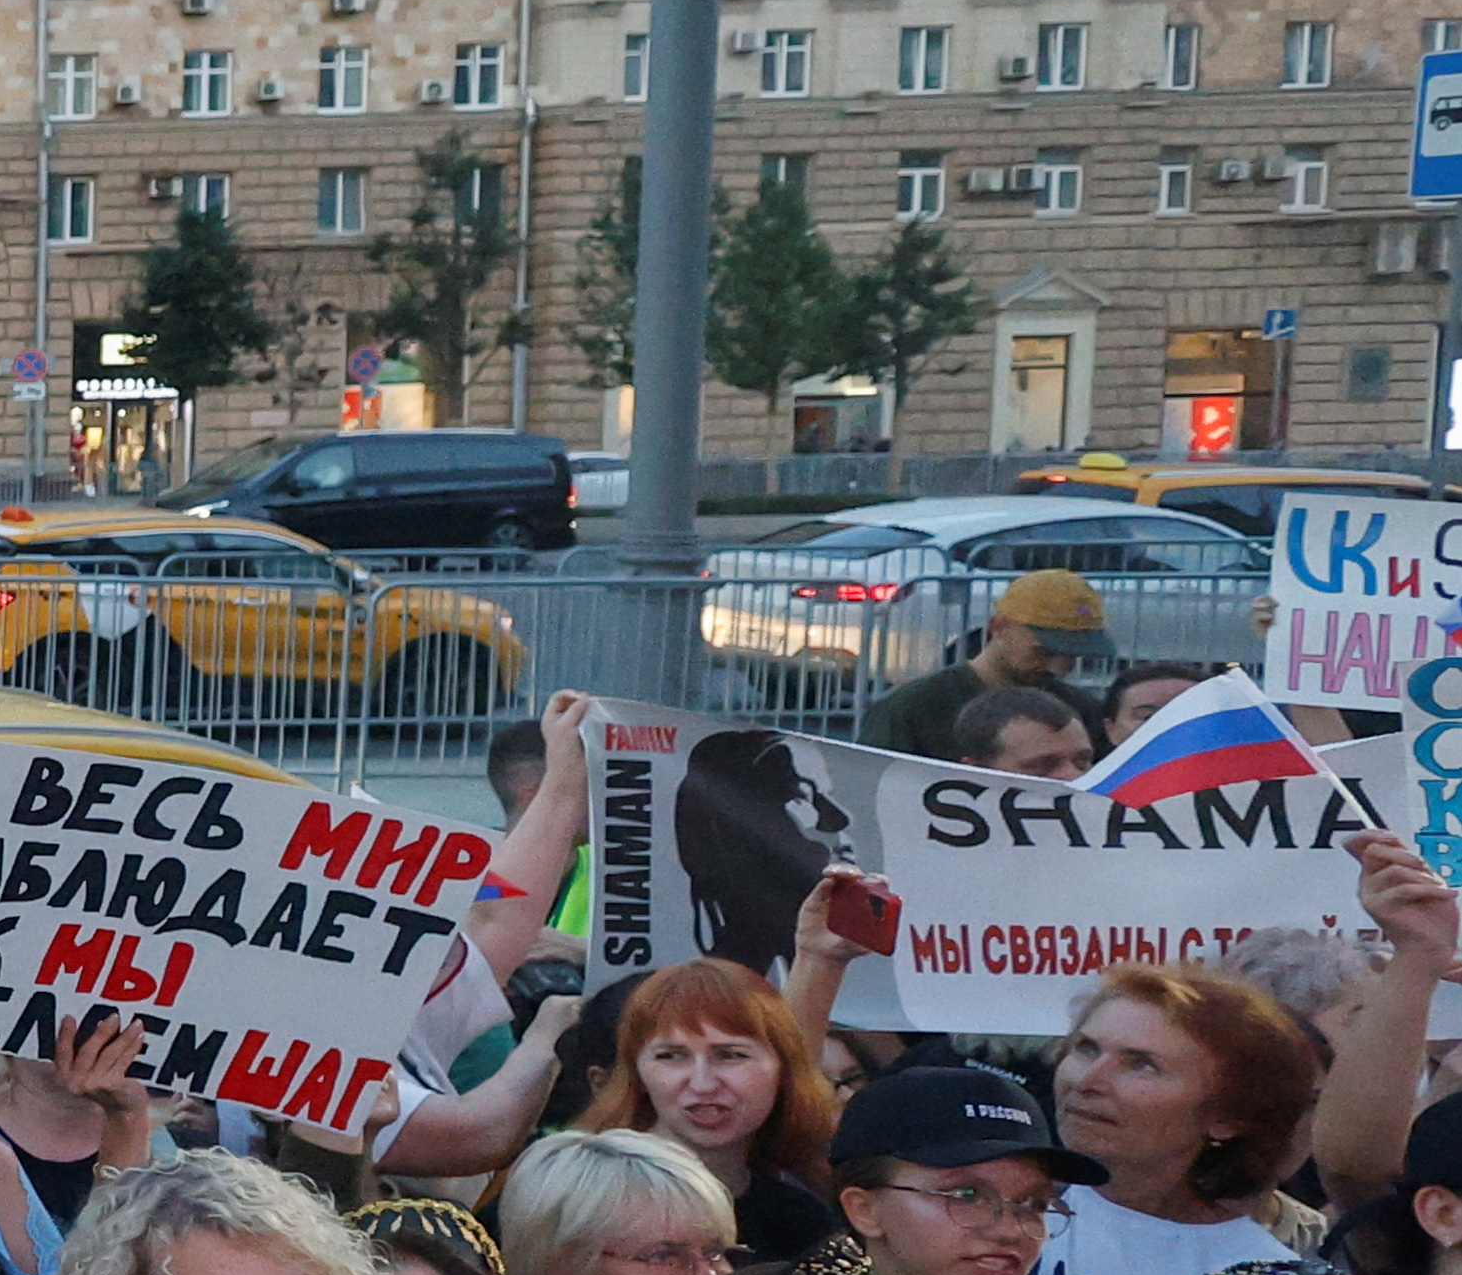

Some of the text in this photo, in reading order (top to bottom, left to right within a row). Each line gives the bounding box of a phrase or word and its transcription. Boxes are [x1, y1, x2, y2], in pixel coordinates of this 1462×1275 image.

[605, 723, 679, 753] FAMILY
[10, 757, 245, 851] ВЕСЬ
[279, 802, 493, 907] МИР
[603, 759, 652, 966] SHAMAN
[35, 924, 195, 1007] МЫ
[910, 925, 971, 975] МЫ
[982, 925, 1165, 976] СВЯЗАНЫ
[217, 1029, 392, 1130] ШАГ
